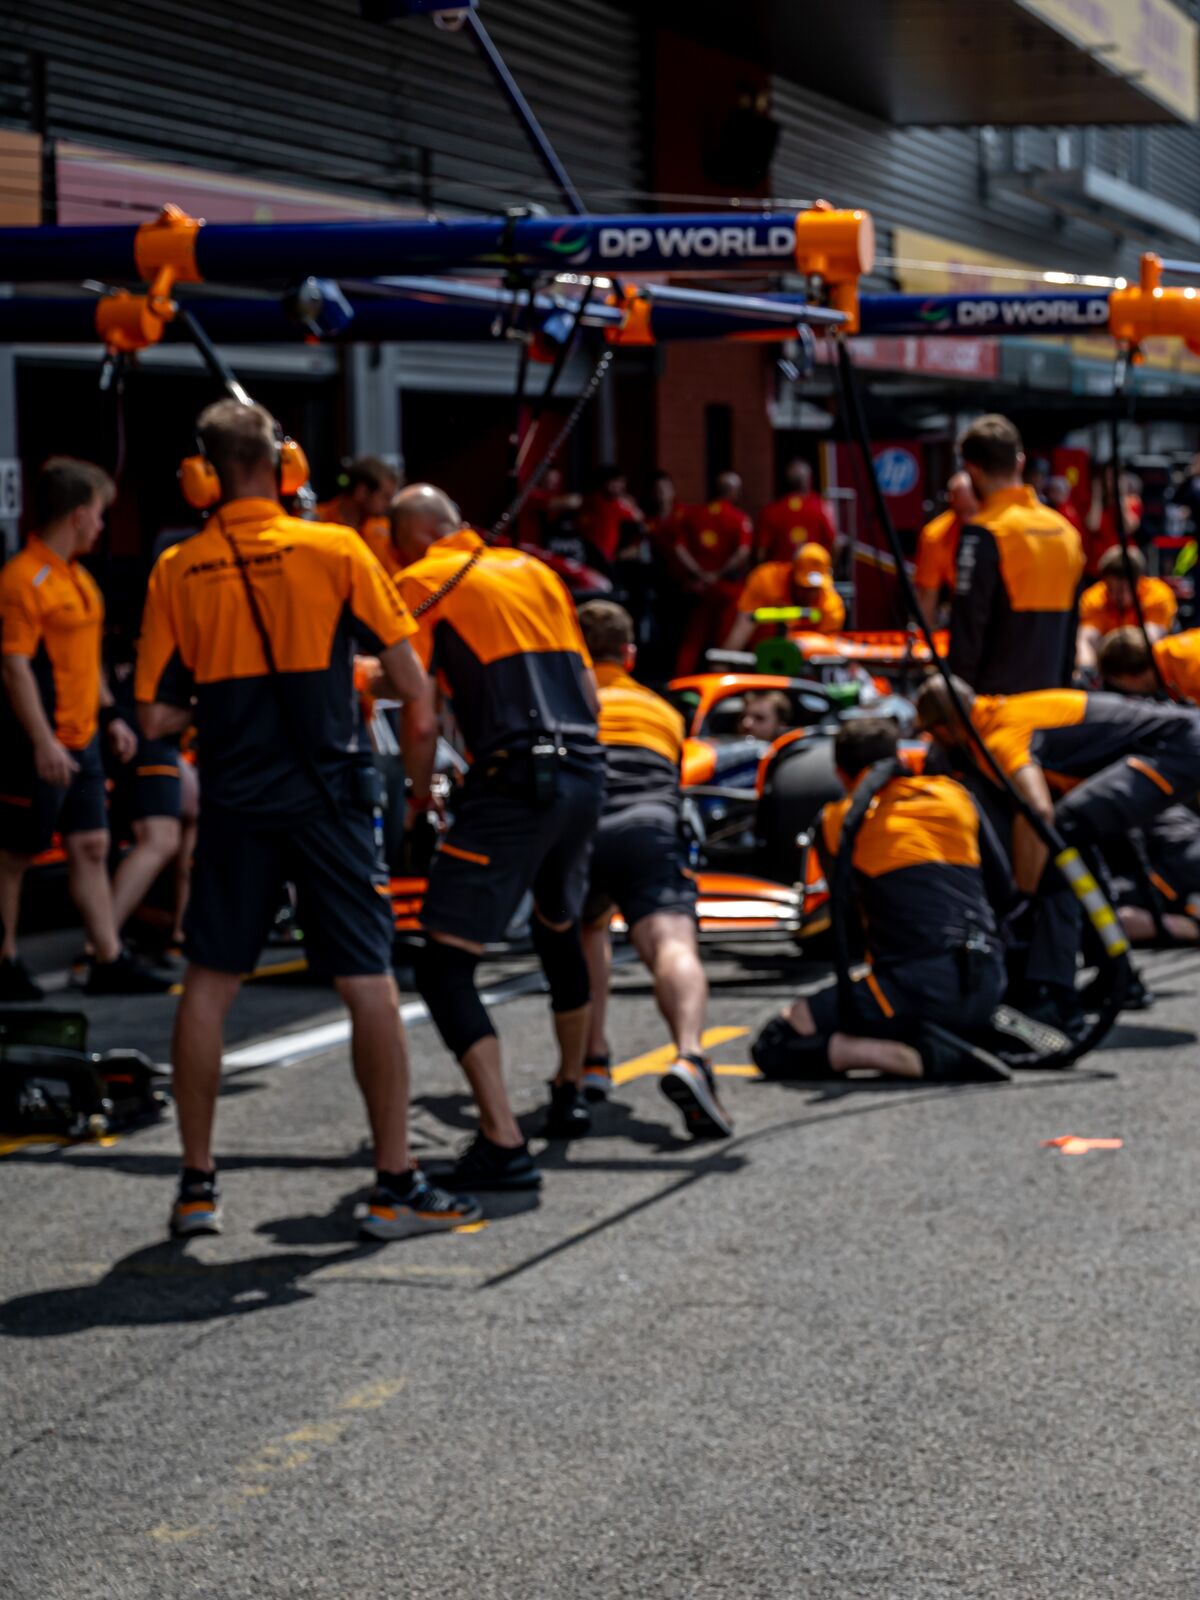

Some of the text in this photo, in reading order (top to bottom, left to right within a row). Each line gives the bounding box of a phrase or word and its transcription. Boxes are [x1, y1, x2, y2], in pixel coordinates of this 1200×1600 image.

[600, 227, 795, 257] DP WORLD
[957, 300, 1109, 325] DP WORLD
